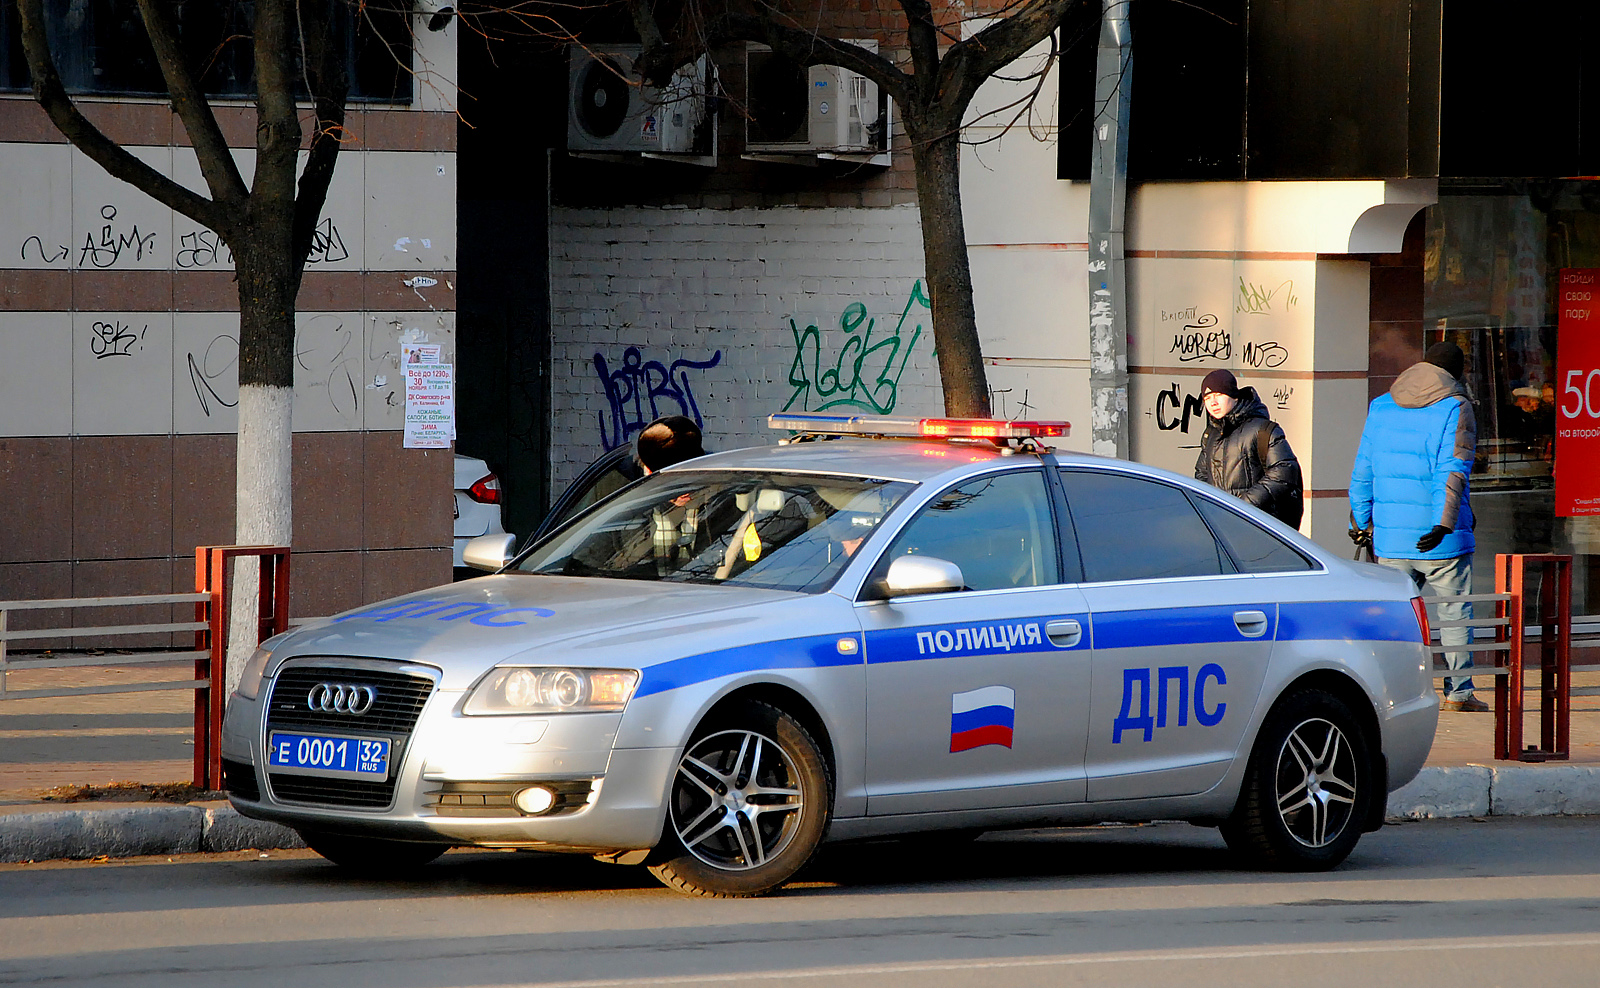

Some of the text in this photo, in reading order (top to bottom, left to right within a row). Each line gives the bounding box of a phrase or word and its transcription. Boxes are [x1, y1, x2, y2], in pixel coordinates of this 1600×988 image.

[1563, 271, 1595, 284] найди
[1565, 291, 1592, 301] свою
[1565, 308, 1591, 321] пару
[1559, 430, 1571, 438] на
[331, 600, 556, 628] ДПС
[916, 622, 1042, 655] ПОЛИЦИЯ
[1111, 663, 1228, 744] ДПС
[297, 737, 348, 768] 0001
[360, 740, 382, 763] 32
[361, 762, 378, 773] RUS
